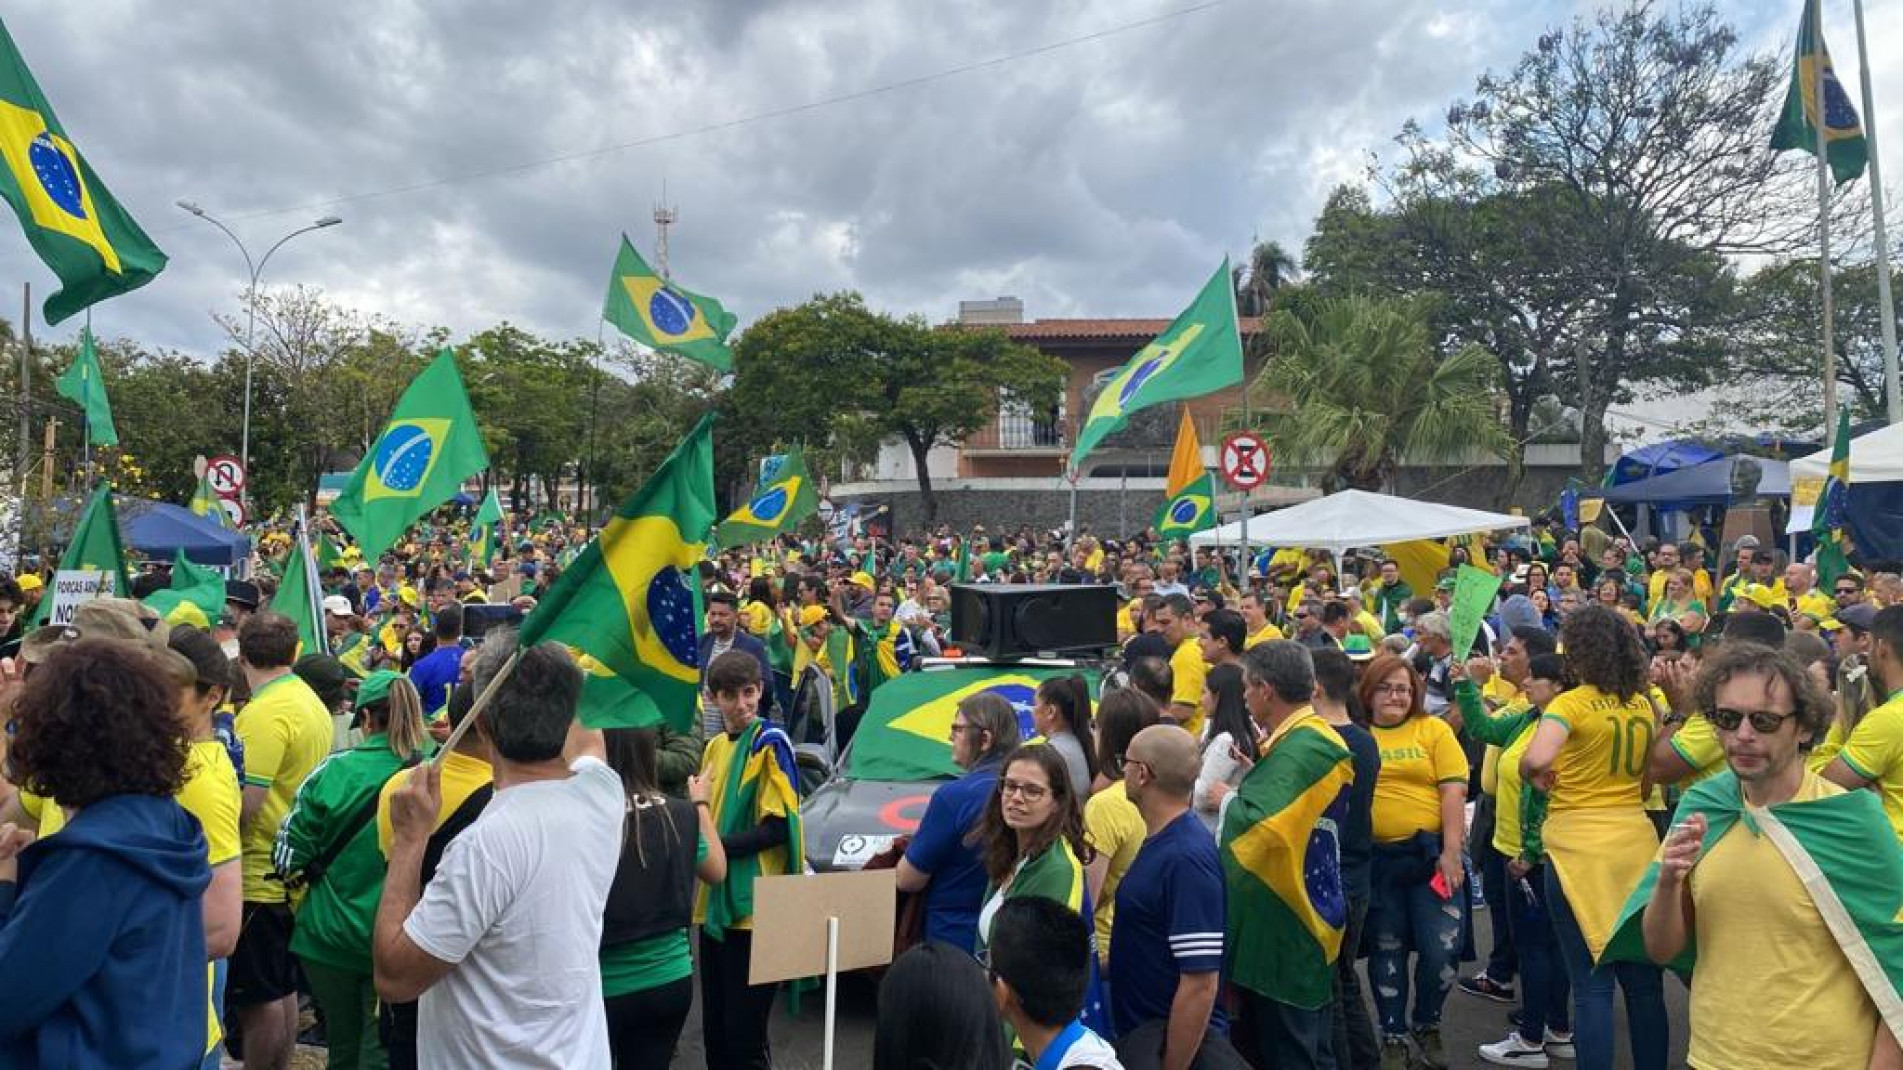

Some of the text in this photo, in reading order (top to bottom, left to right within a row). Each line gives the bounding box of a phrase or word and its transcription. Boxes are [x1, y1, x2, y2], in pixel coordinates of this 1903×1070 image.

[57, 580, 83, 594] FORÇAS
[1607, 714, 1652, 777] 10
[1380, 747, 1427, 760] ASIL
